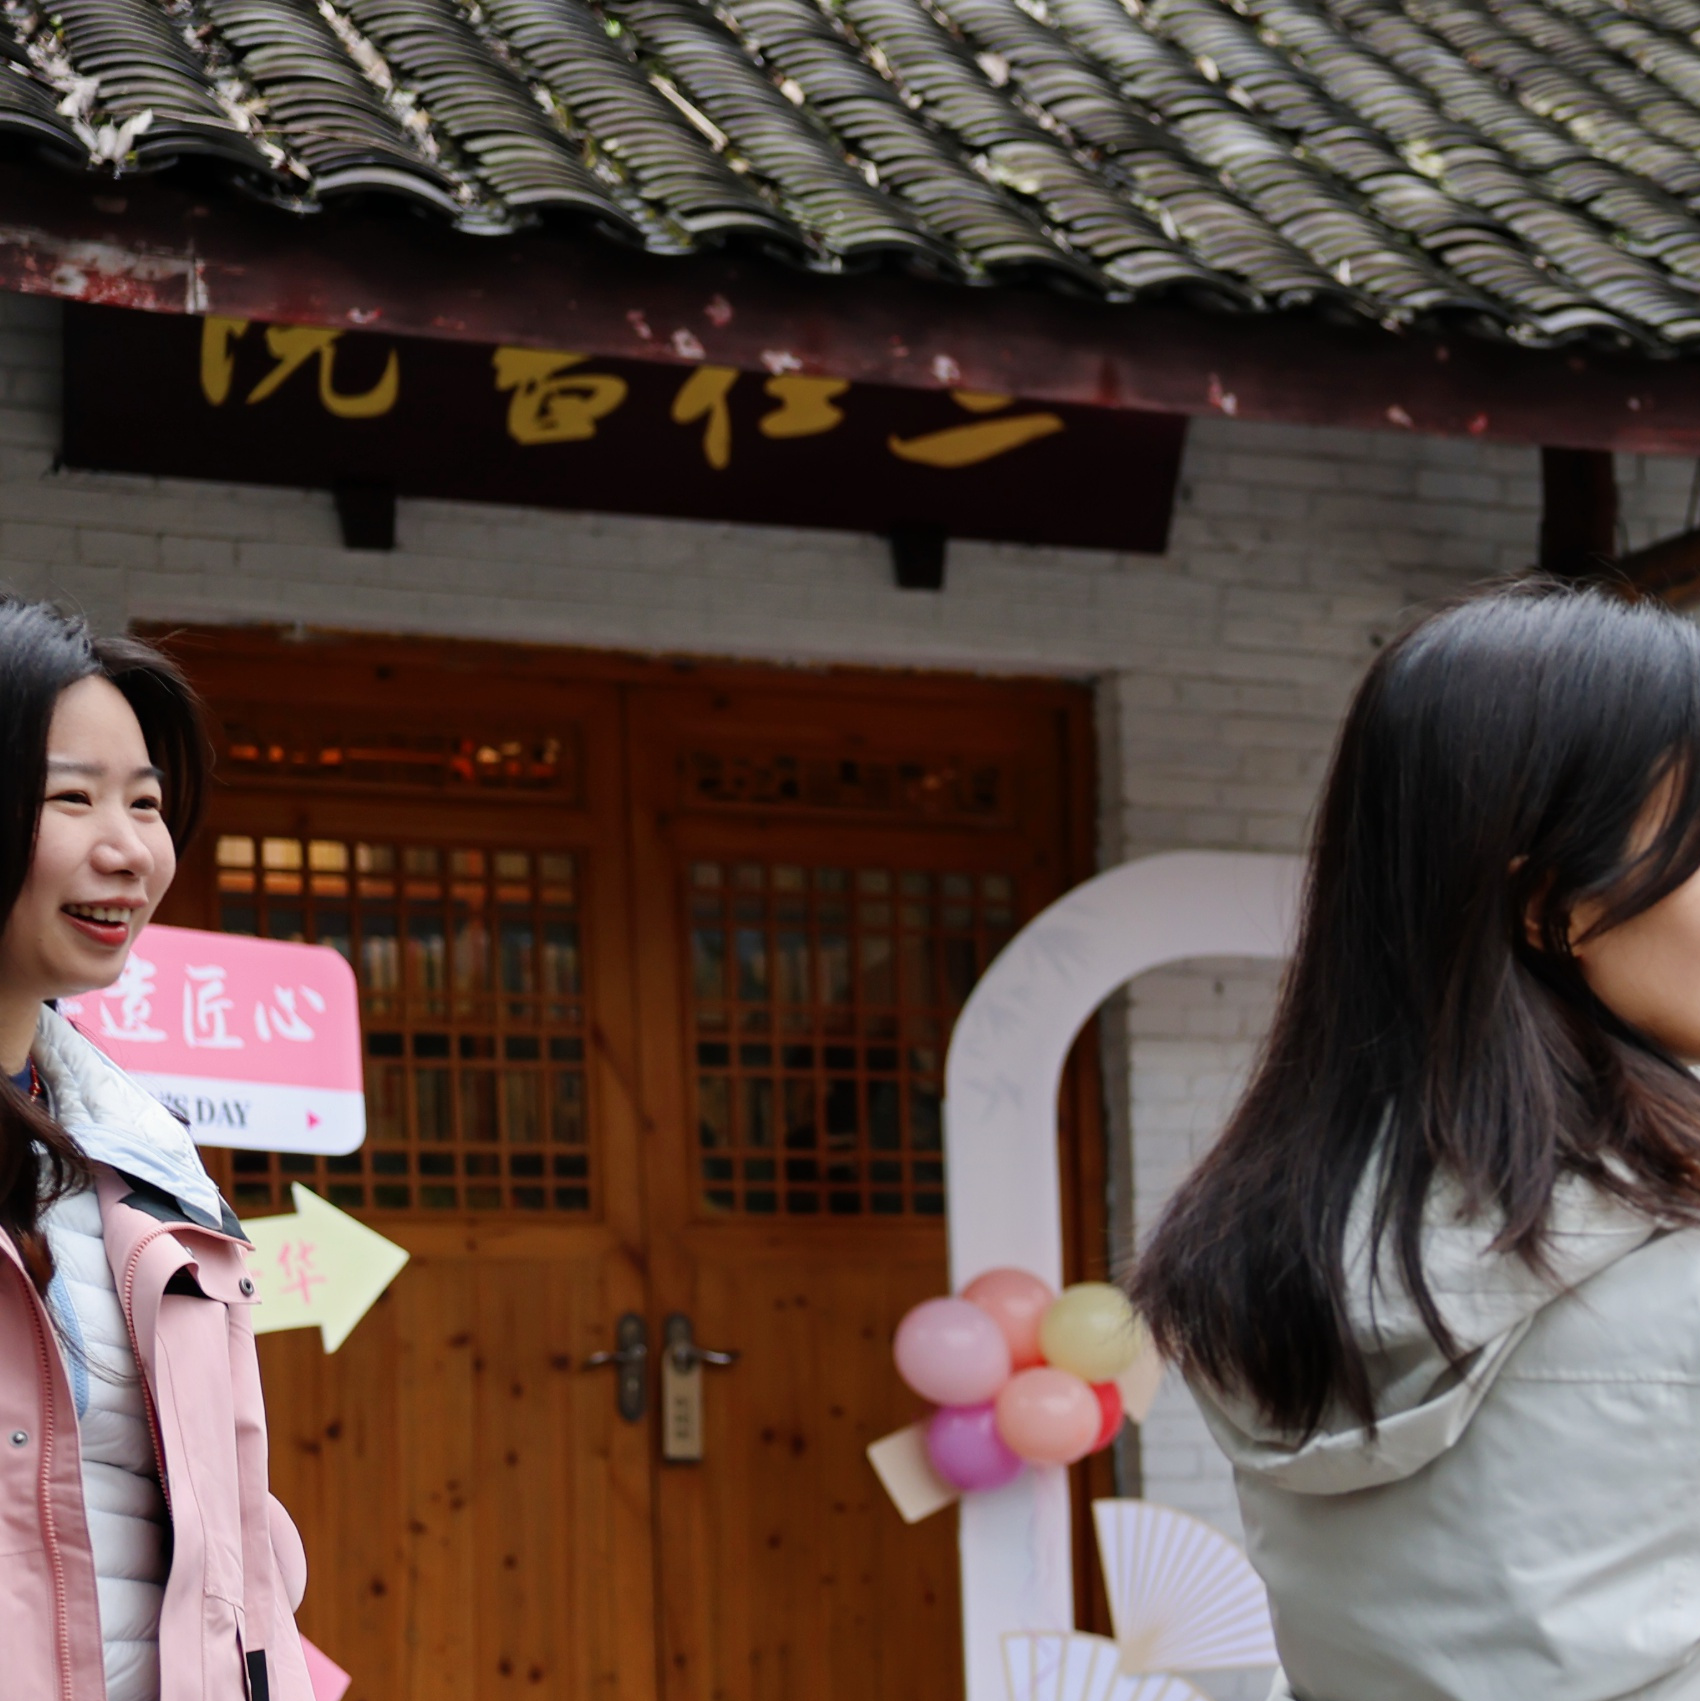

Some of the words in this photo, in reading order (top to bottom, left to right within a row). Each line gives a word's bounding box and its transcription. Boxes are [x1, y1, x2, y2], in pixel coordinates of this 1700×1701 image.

[64, 950, 326, 1048] 遗匠心
[196, 1096, 251, 1128] DAY
[244, 1239, 328, 1305] 华
